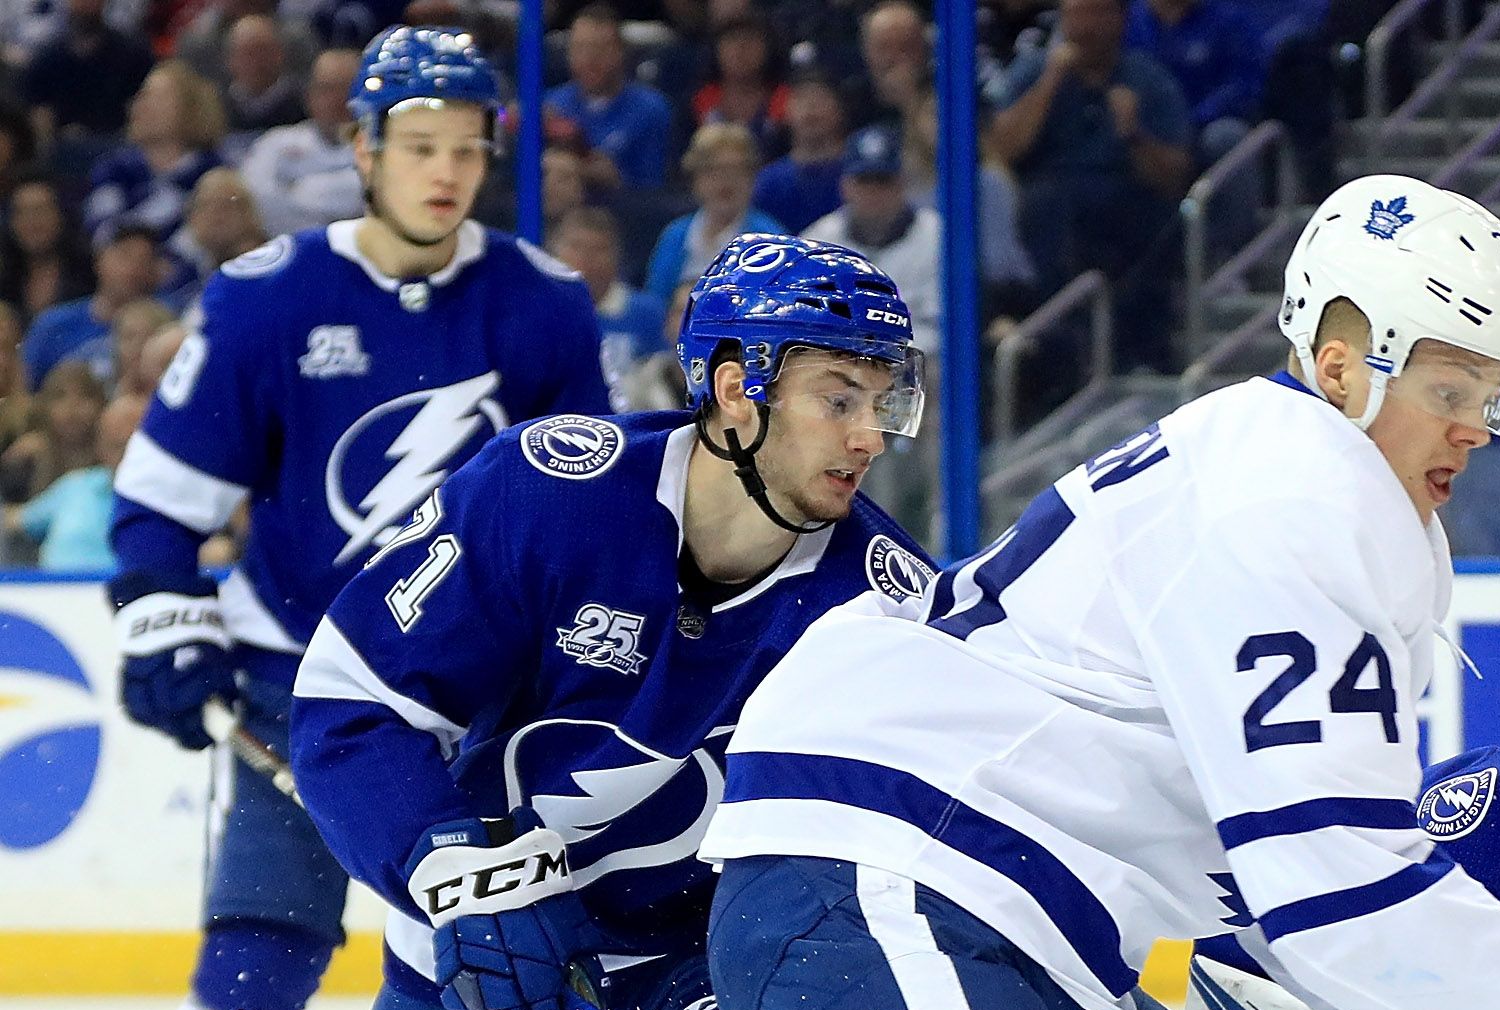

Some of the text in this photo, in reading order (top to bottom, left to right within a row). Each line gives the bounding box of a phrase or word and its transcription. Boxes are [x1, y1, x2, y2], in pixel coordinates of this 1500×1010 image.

[866, 308, 908, 327] CCM
[594, 425, 615, 439] BAY
[547, 440, 616, 472] LIGHTNING
[873, 546, 886, 569] BAY
[574, 603, 645, 658] 25
[612, 656, 631, 669] 2017
[1236, 630, 1399, 754] 24
[1426, 794, 1486, 834] LIGHTNING
[431, 833, 468, 846] CIRELLI
[422, 849, 568, 916] CCM
